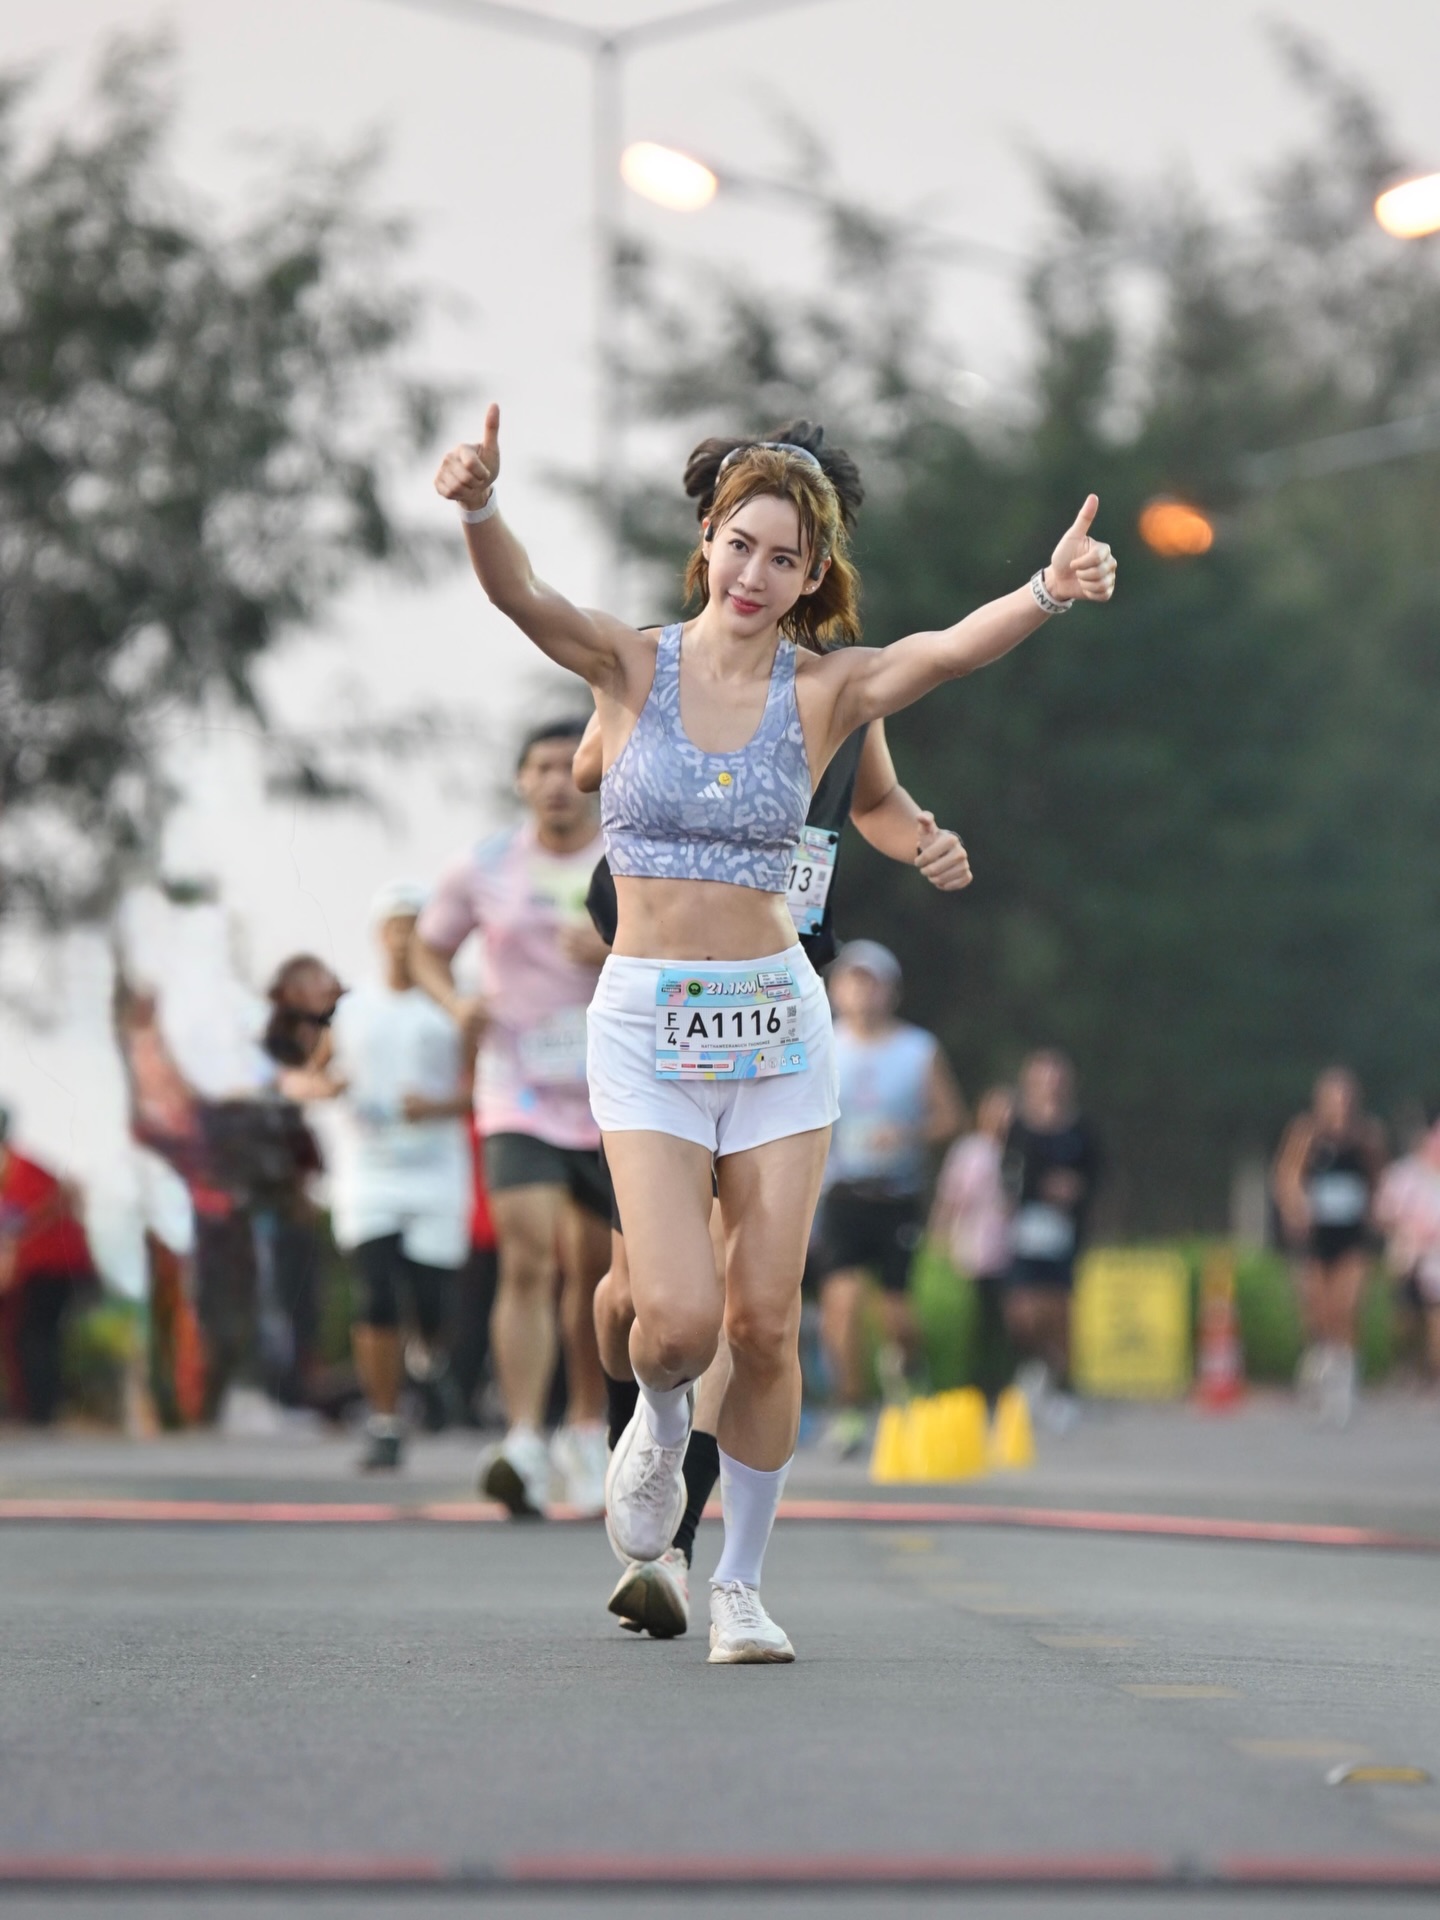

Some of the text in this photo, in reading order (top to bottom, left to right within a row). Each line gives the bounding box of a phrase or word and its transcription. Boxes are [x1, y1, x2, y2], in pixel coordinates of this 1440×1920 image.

[706, 980, 757, 996] 21.1KM
[667, 1012, 677, 1026] F
[686, 1007, 781, 1038] A1116
[667, 1031, 677, 1046] 4
